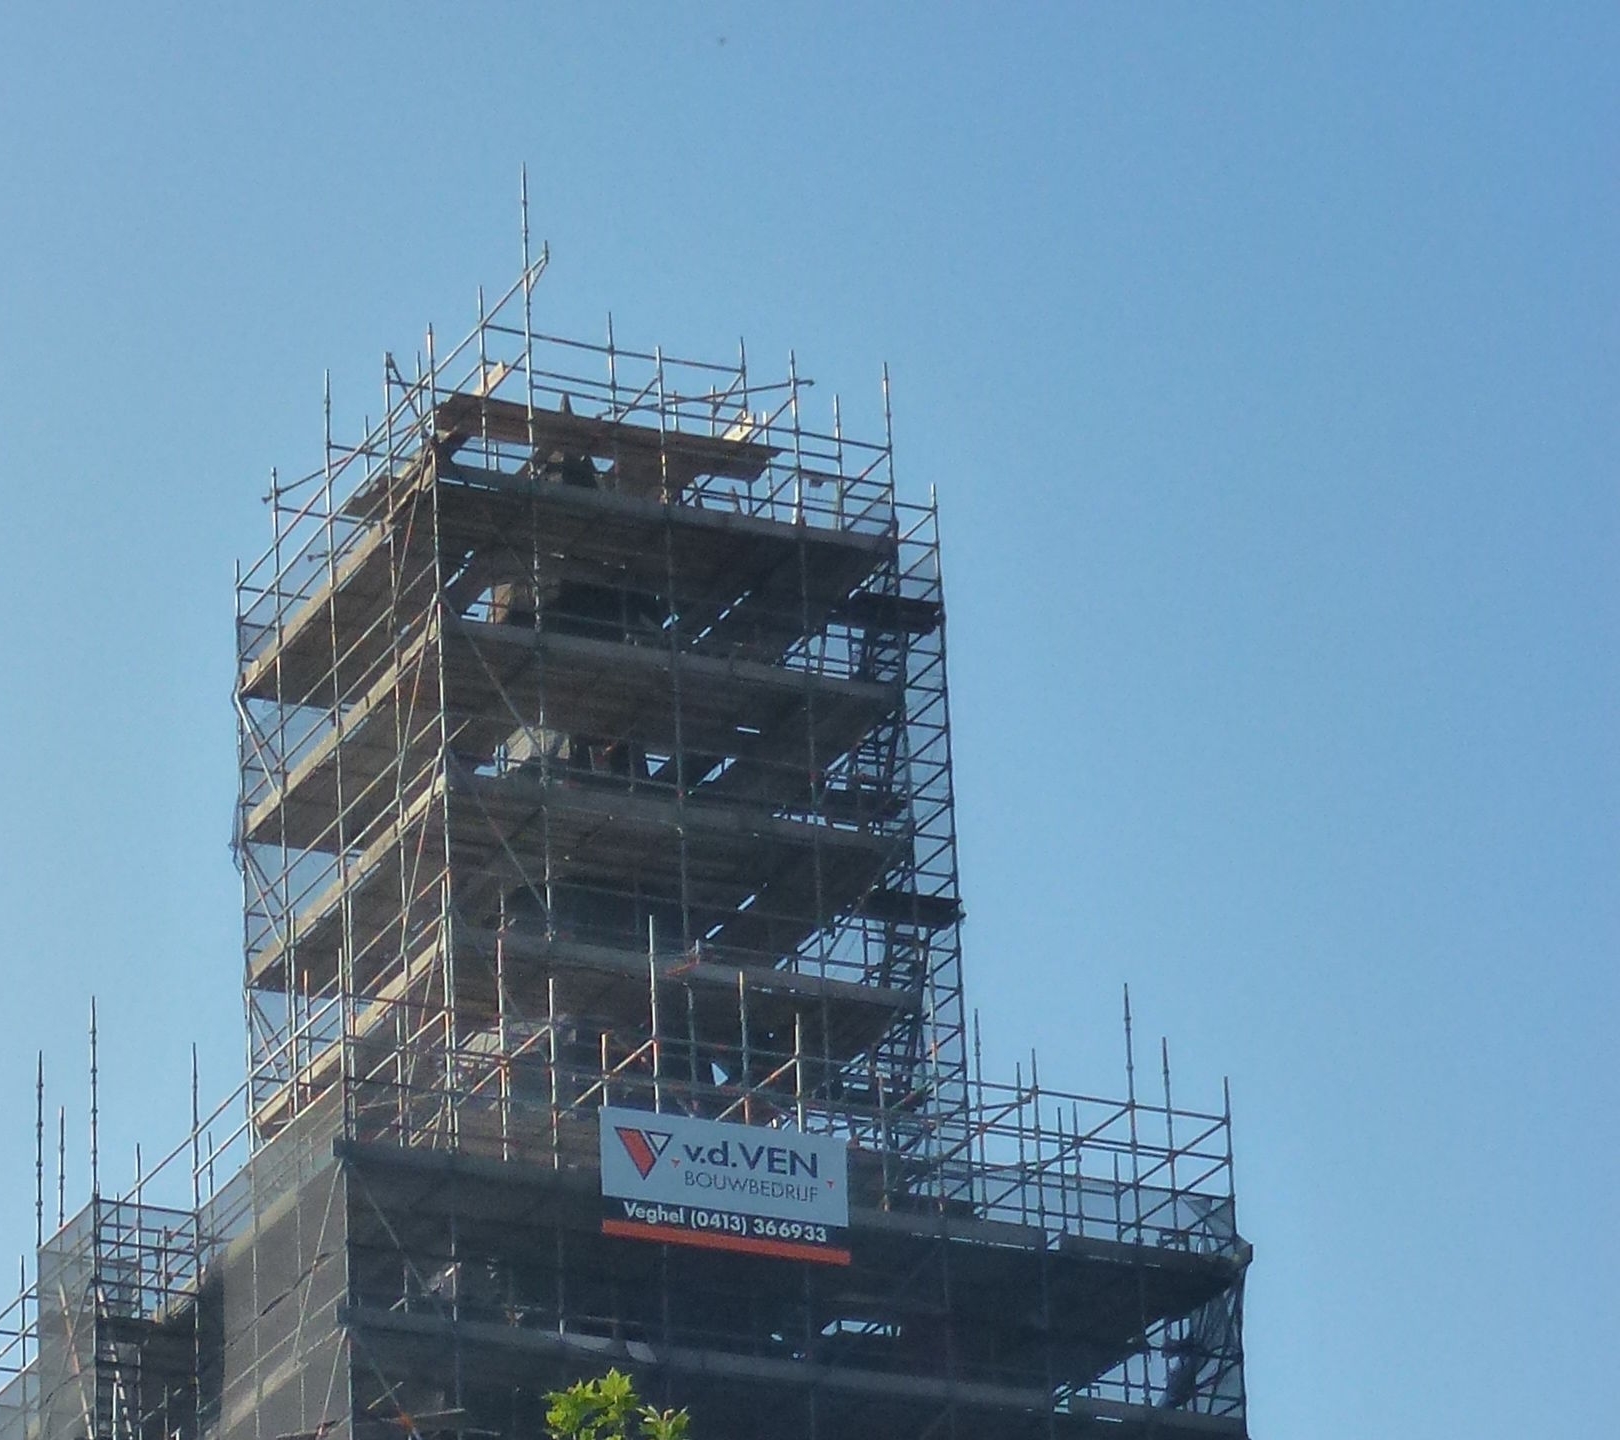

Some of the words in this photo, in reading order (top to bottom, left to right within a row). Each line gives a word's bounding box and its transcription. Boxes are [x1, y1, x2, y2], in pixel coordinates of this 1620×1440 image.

[683, 1140, 819, 1179] v.d.VEN
[684, 1170, 819, 1203] BOUWBEDRIJF
[623, 1200, 685, 1225] Veghel
[690, 1211, 747, 1236] (0413)
[753, 1218, 827, 1243] 366933
